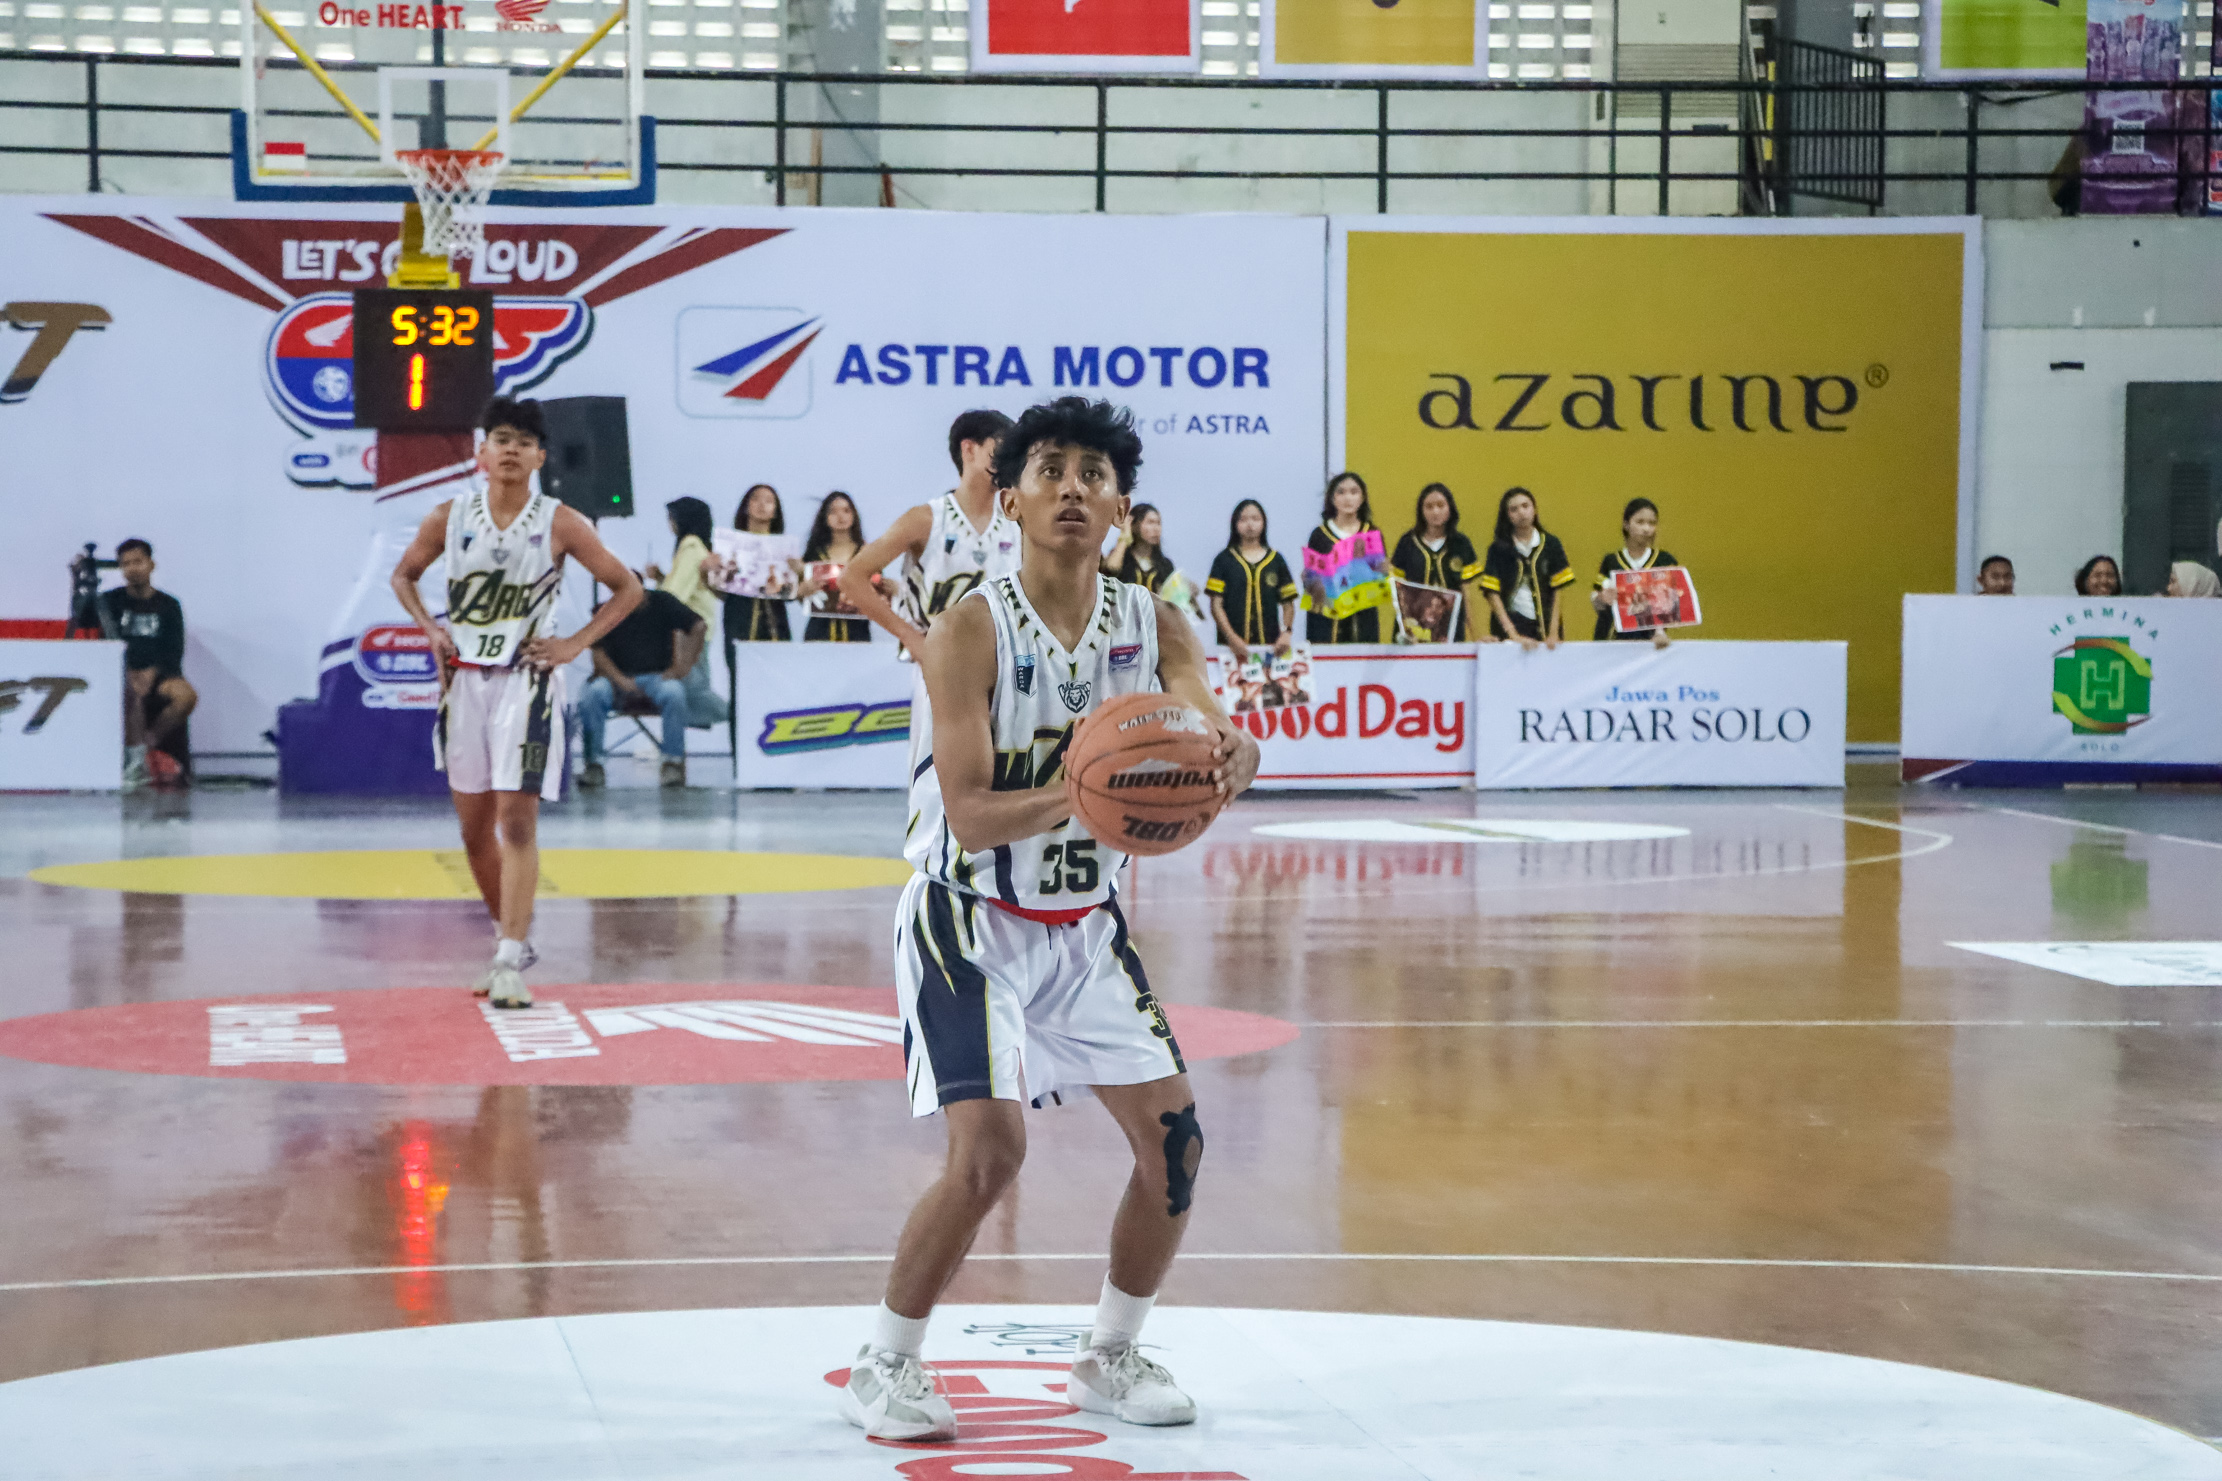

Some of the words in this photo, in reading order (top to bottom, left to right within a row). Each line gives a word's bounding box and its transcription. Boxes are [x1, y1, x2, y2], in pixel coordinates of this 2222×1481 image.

[319, 1, 371, 26] One
[282, 239, 380, 281] LET'S
[391, 305, 480, 346] 5:32
[408, 352, 426, 411] 1
[834, 344, 1033, 386] ASTRA
[1053, 346, 1271, 388] MOTOR
[1186, 415, 1270, 434] ASTRA
[2050, 607, 2159, 641] HERMINA
[476, 634, 505, 658] 18
[1605, 685, 1669, 702] Jawa
[1678, 685, 1720, 702] Pos
[1217, 686, 1347, 741] ood
[1358, 683, 1465, 753] Day
[1518, 708, 1679, 742] RADAR
[1690, 707, 1811, 743] SOLO
[1039, 839, 1099, 895] 35
[1135, 991, 1173, 1039] 3
